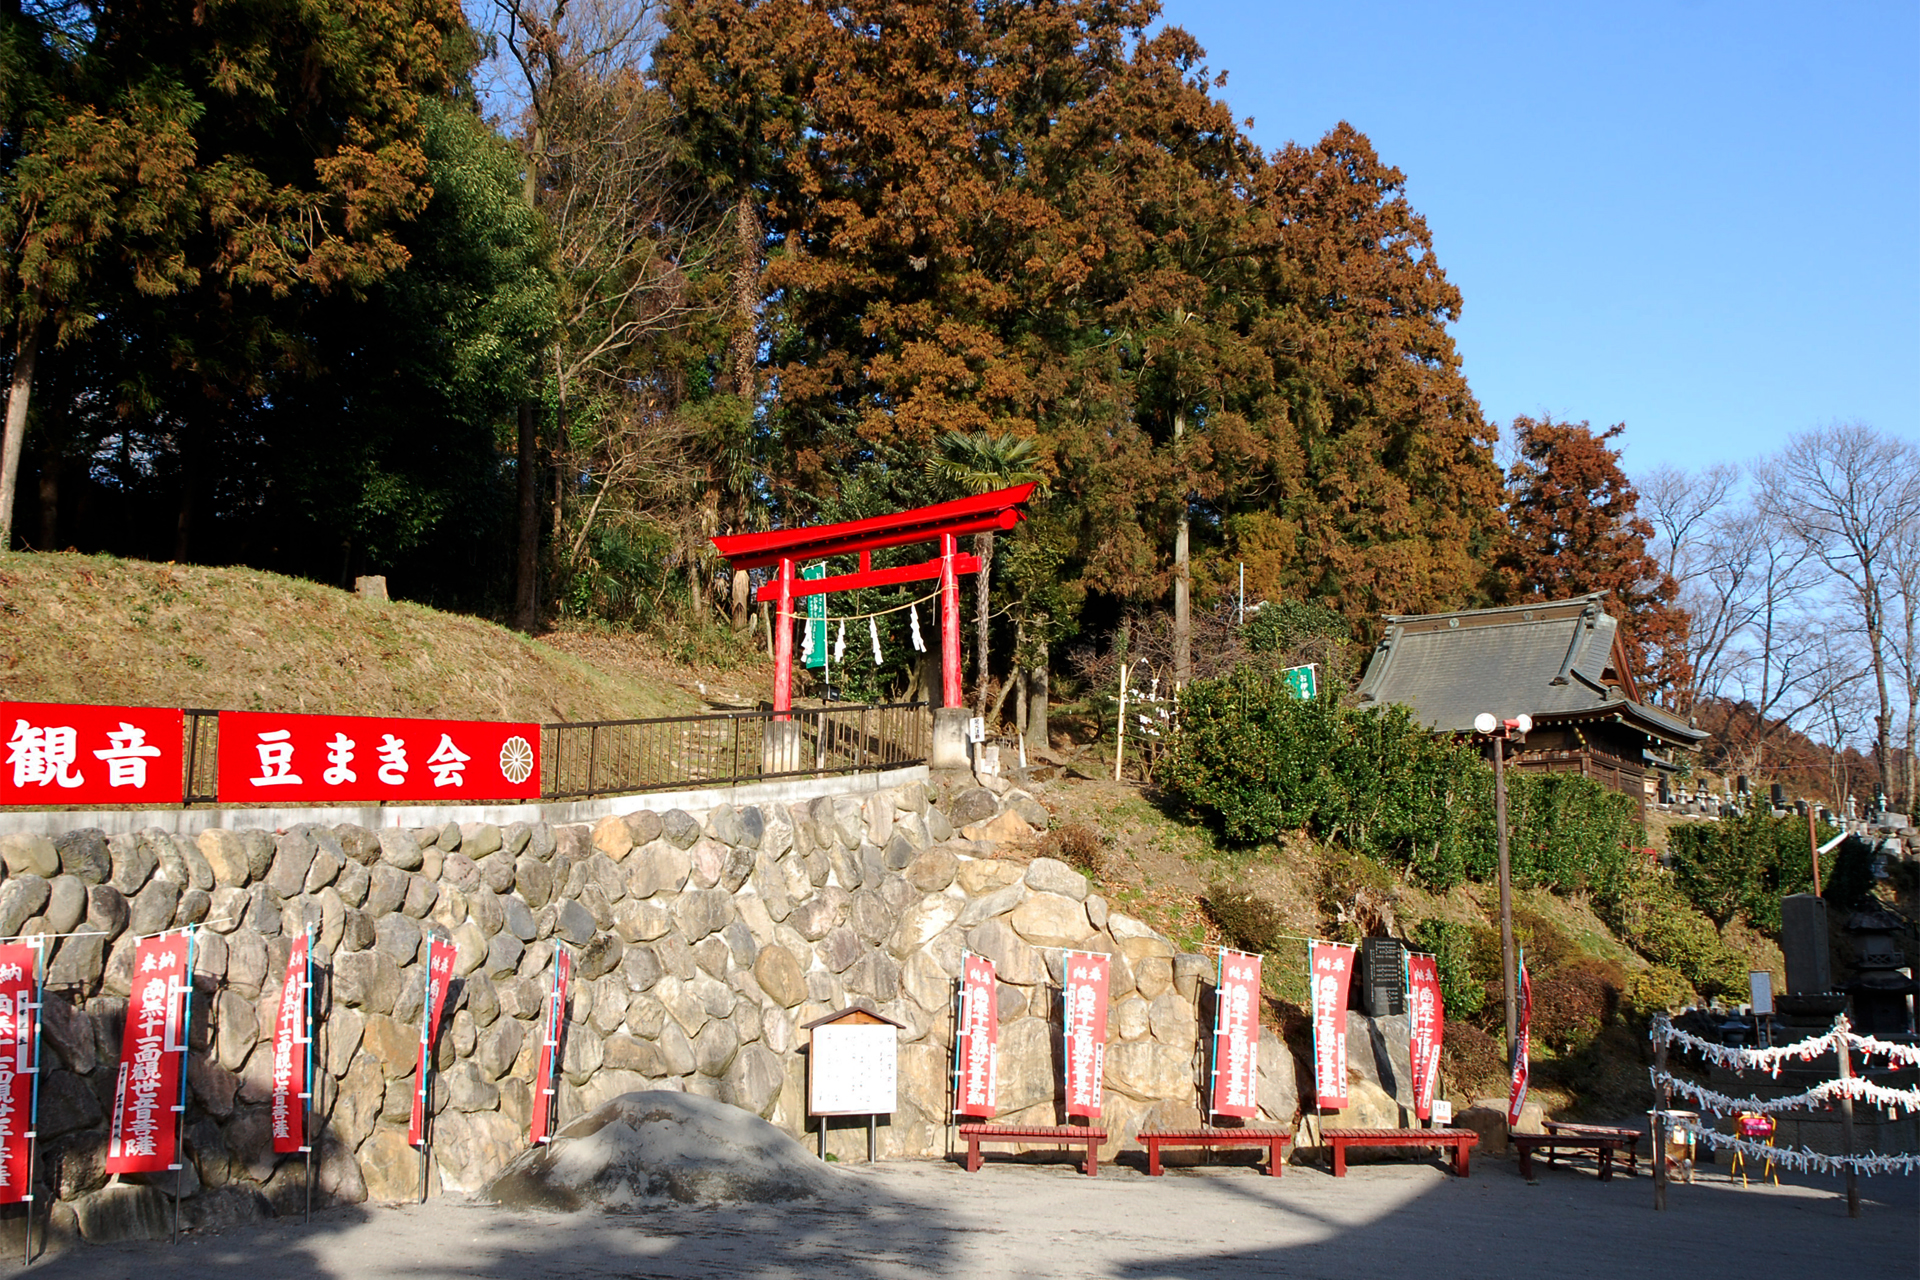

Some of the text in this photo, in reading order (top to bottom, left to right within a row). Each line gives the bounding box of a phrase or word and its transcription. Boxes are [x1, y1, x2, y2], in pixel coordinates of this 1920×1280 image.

[5, 719, 161, 789] 観音
[249, 729, 472, 787] 豆まき会
[140, 951, 176, 973] 奉納
